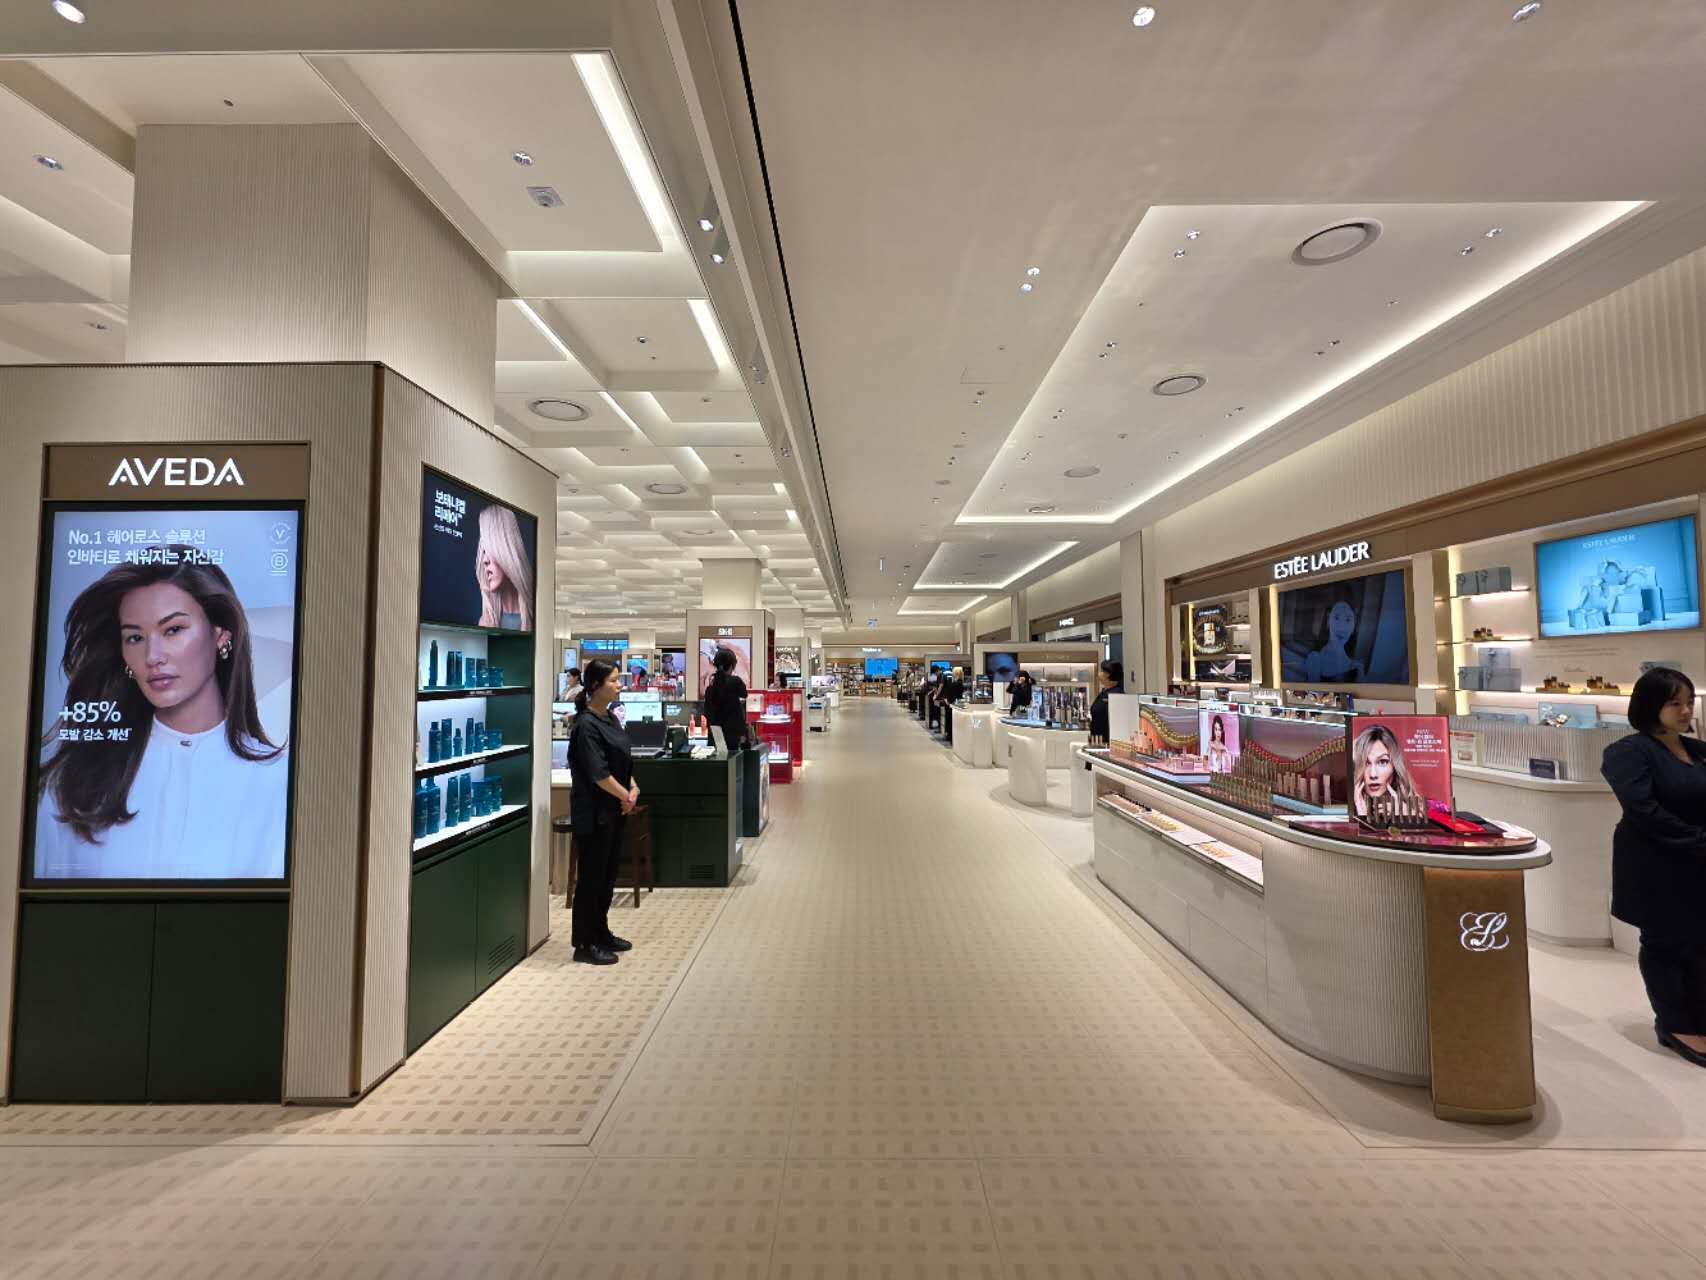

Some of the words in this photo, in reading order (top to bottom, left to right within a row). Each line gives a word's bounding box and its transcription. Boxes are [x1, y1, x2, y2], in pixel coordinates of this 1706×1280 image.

[108, 457, 245, 486] AVEDA
[68, 530, 102, 545] No.1
[106, 529, 162, 544] 헤어로스
[67, 549, 122, 565] 인바티로
[125, 549, 180, 565] 채워지는
[184, 549, 224, 565] 자신감
[1273, 556, 1309, 580] ESTÉE
[1311, 541, 1370, 572] LAUDER
[58, 700, 122, 723] +85%
[58, 728, 81, 741] 모발
[83, 728, 105, 741] 감소
